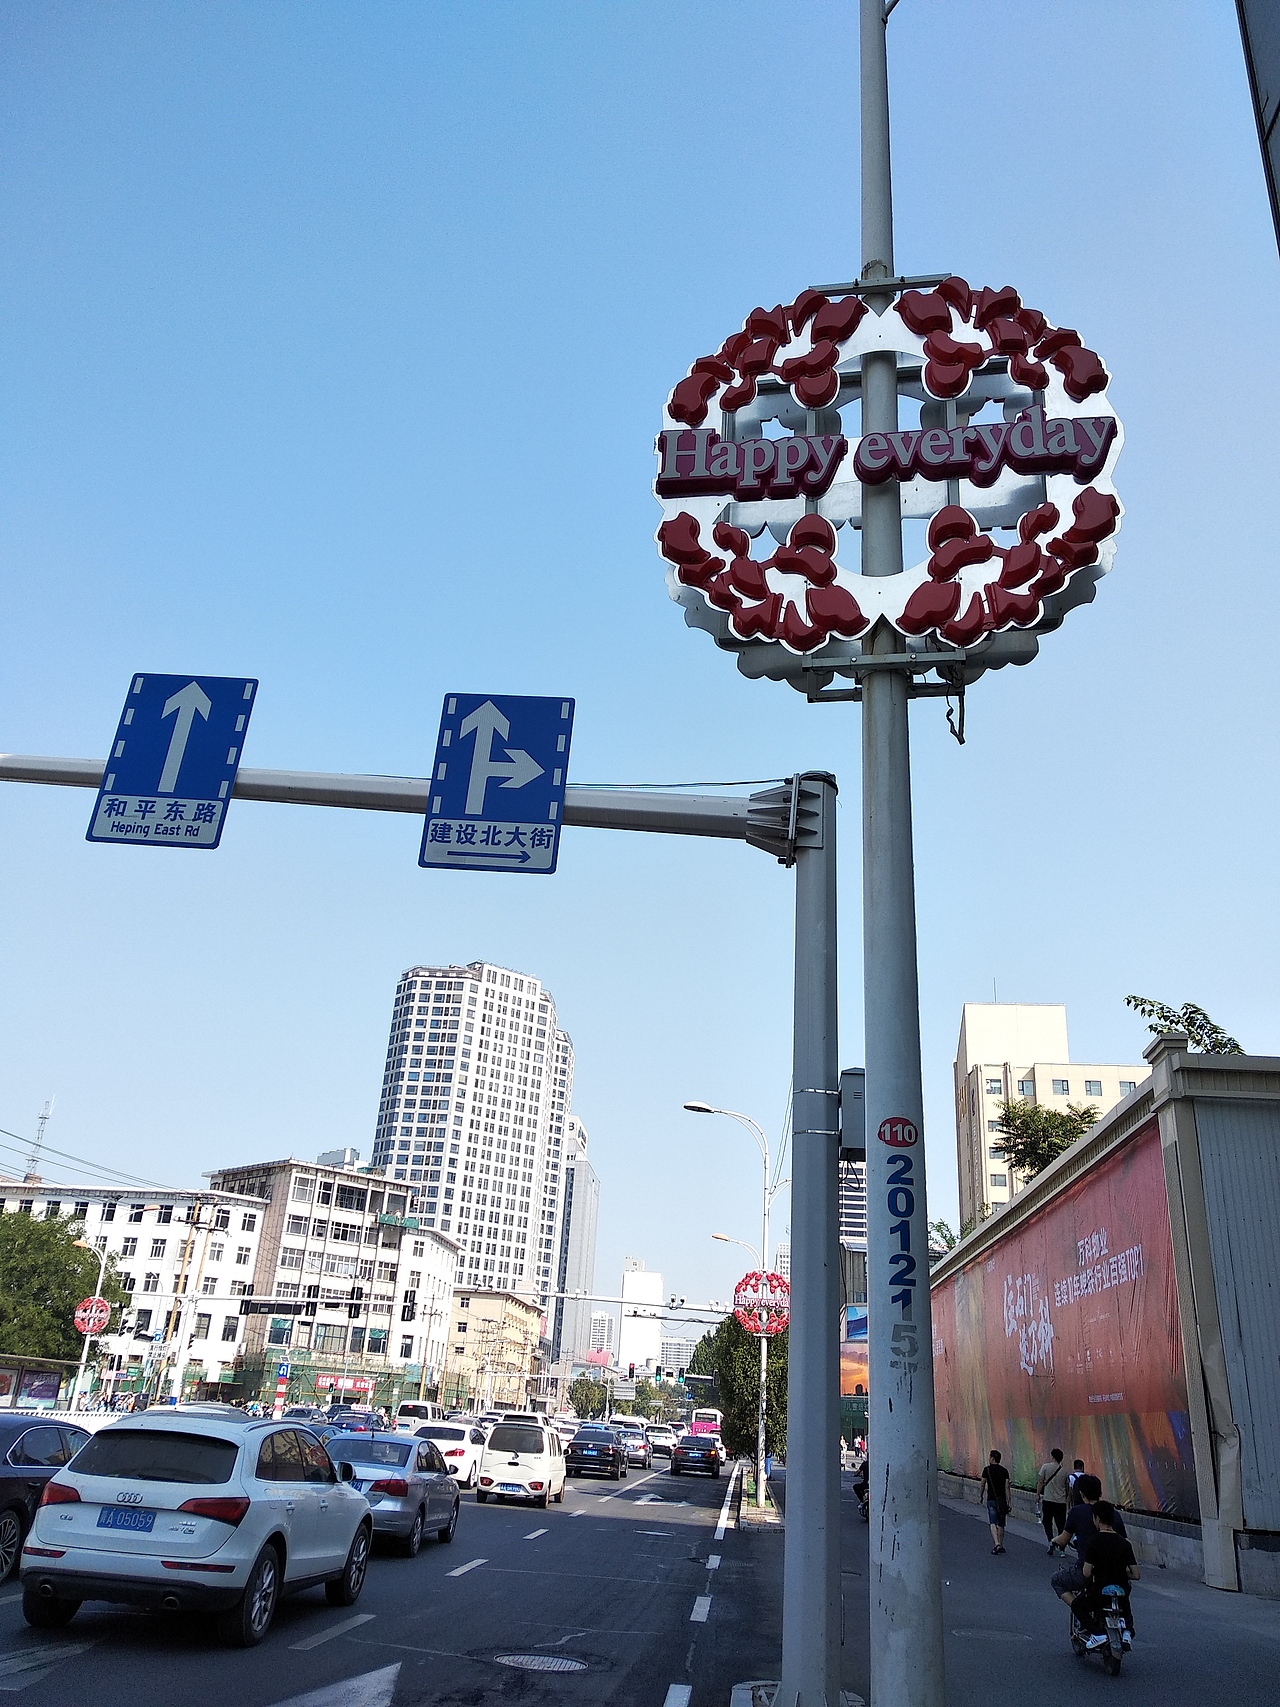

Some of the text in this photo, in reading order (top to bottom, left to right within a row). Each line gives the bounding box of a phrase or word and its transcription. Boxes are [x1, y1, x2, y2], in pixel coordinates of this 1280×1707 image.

[659, 408, 1115, 489] Happy everyday
[103, 798, 217, 824] 和平东路
[110, 821, 201, 838] Heping East Rd
[429, 822, 554, 850] 建设北大街
[881, 1122, 916, 1143] 110
[735, 1294, 790, 1309] Happy everyda
